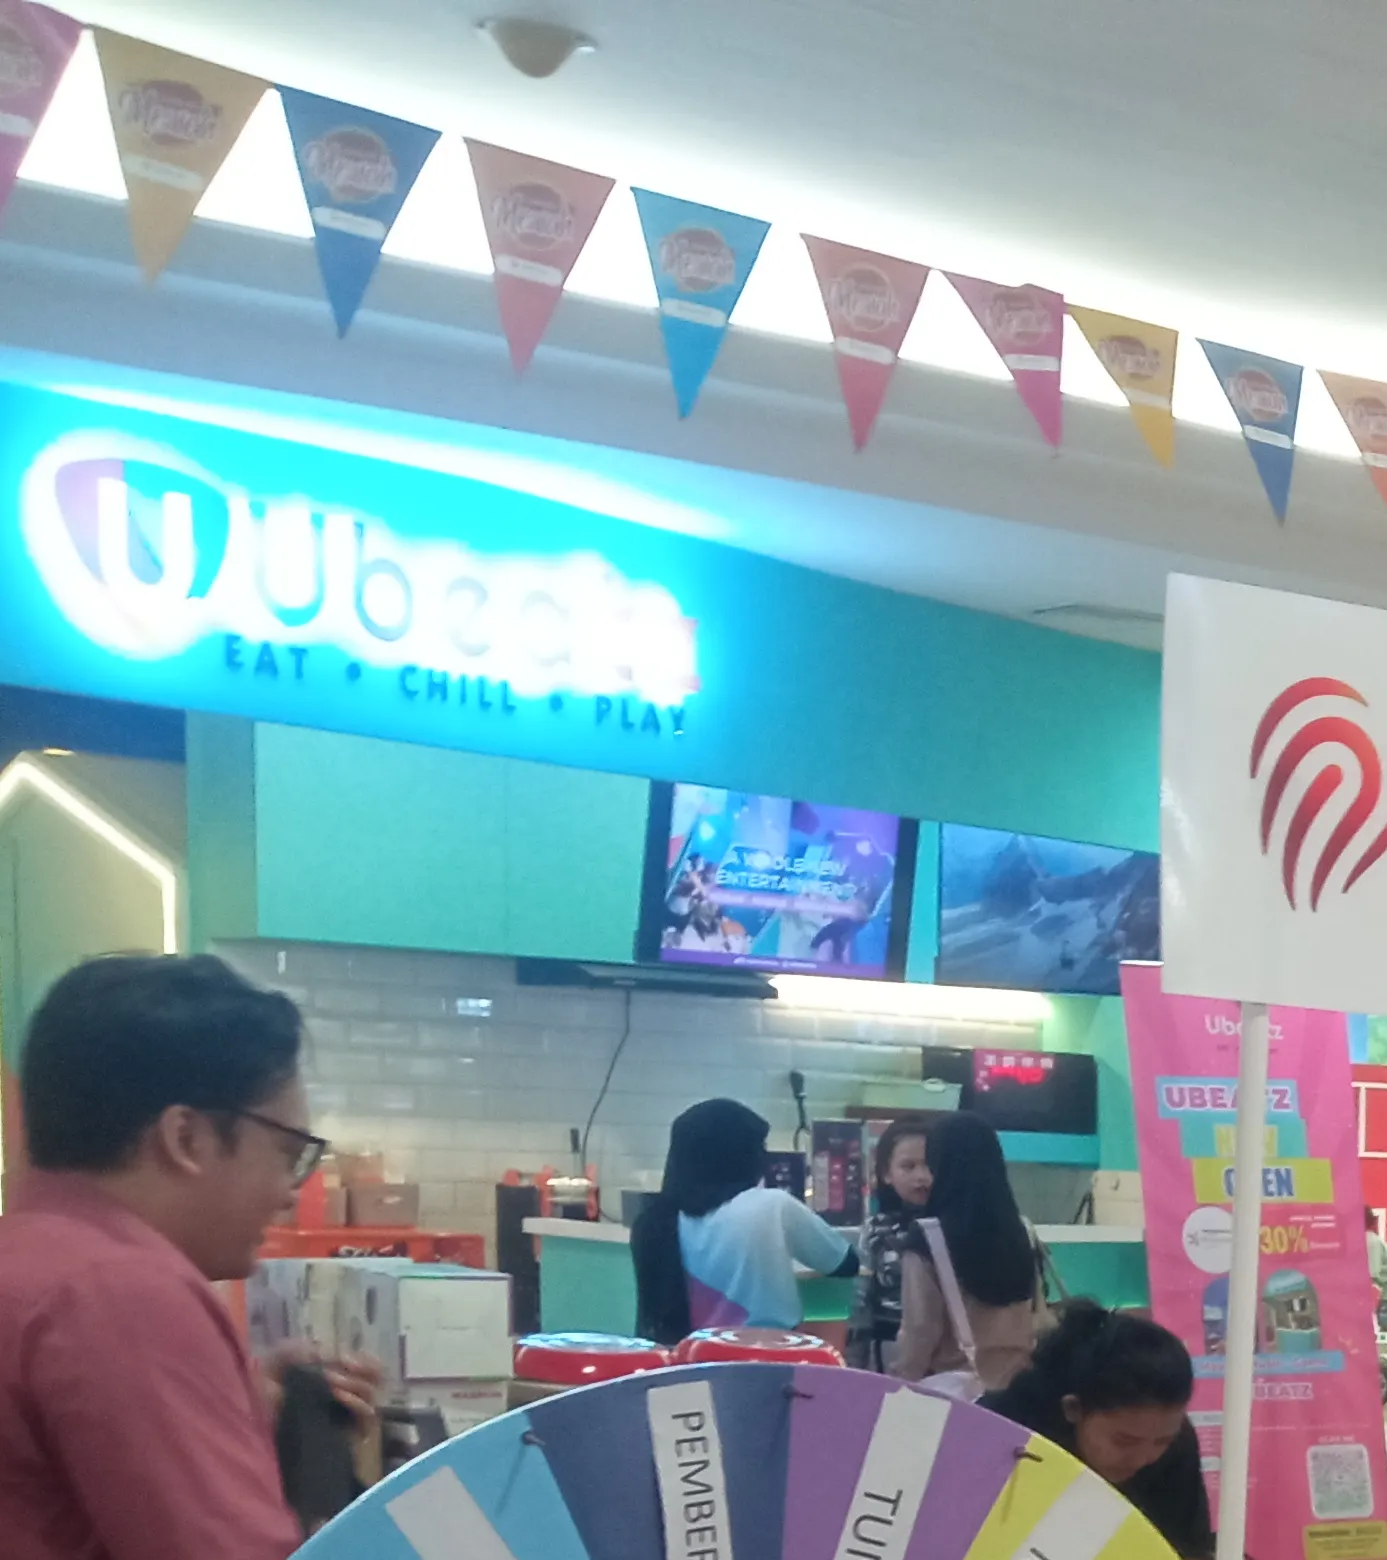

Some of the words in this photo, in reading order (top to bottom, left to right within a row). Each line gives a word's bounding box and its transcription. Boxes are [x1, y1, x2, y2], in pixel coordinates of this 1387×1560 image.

[226, 634, 309, 680] EAT
[399, 666, 519, 714] CHILL
[594, 696, 687, 736] PLAY
[1164, 1086, 1292, 1111] UBEZ
[1224, 1167, 1295, 1198] OEN
